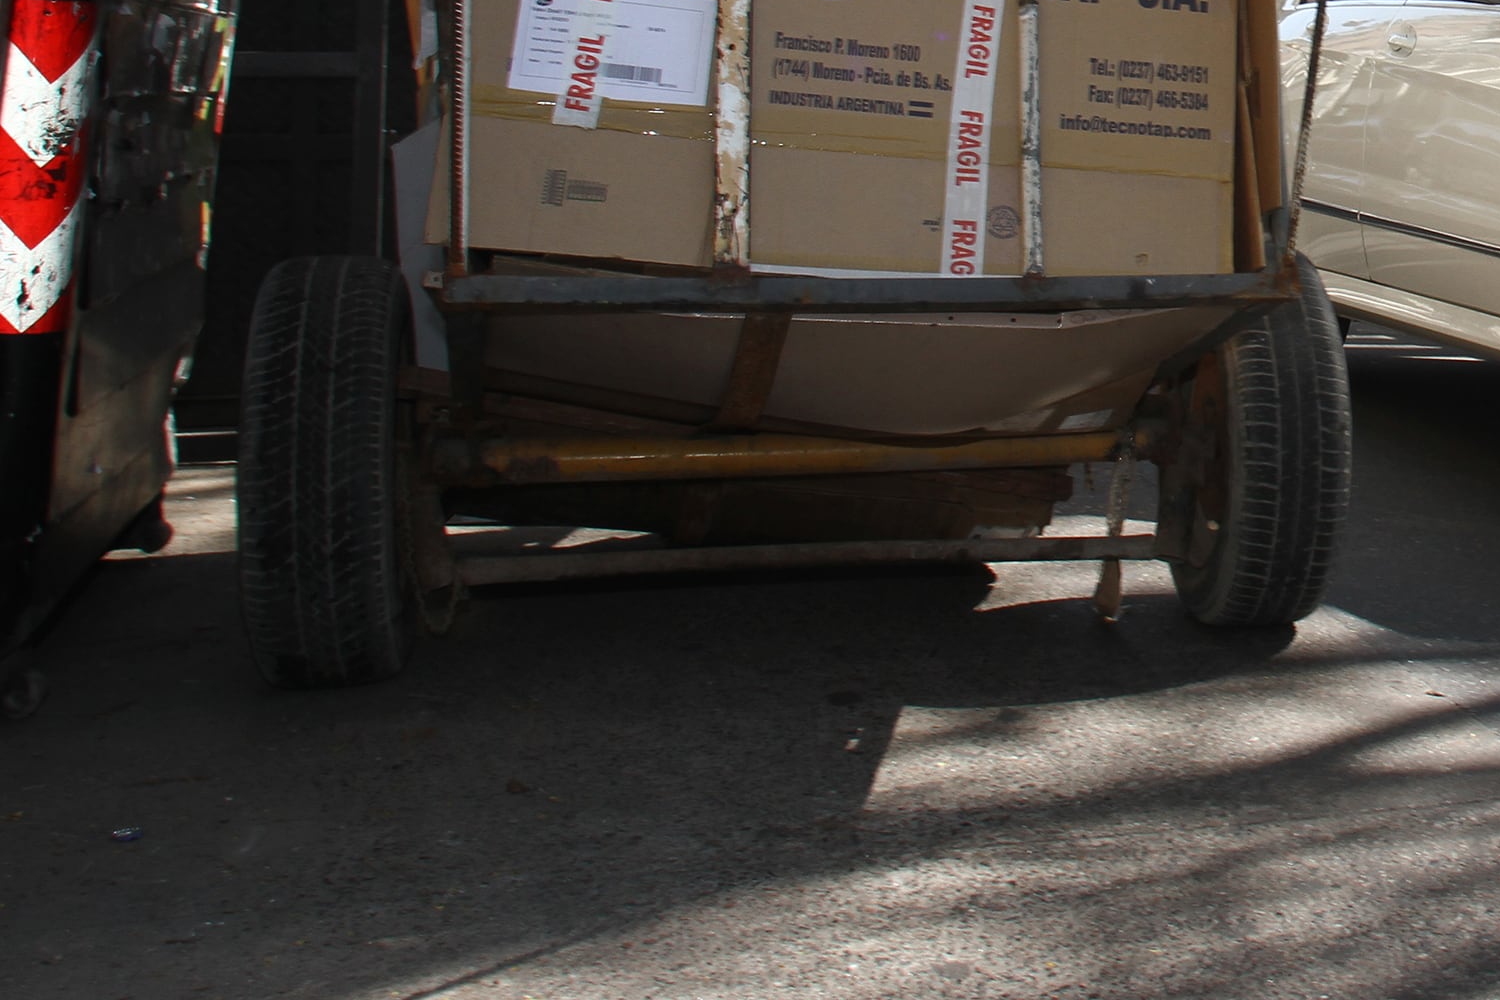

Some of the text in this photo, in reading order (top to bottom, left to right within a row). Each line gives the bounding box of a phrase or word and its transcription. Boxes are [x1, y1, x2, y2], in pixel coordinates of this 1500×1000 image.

[775, 31, 921, 62] Francisco P. Moreno 1600
[965, 4, 996, 78] FRAGIL
[564, 34, 606, 112] FRAGIL
[773, 58, 810, 81] (1744)
[813, 62, 856, 82] Moreno
[864, 67, 893, 86] Pcia.
[896, 70, 911, 88] de
[914, 72, 932, 90] Bs.
[934, 73, 953, 92] As.
[1089, 57, 1209, 84] Tel.: (0237) 463-9151
[769, 90, 906, 117] INDUSTRIA ARGENTINA
[1117, 87, 1154, 111] (0237)
[1059, 114, 1212, 141] info@tecnotap.com
[955, 110, 984, 186] FRAGIL
